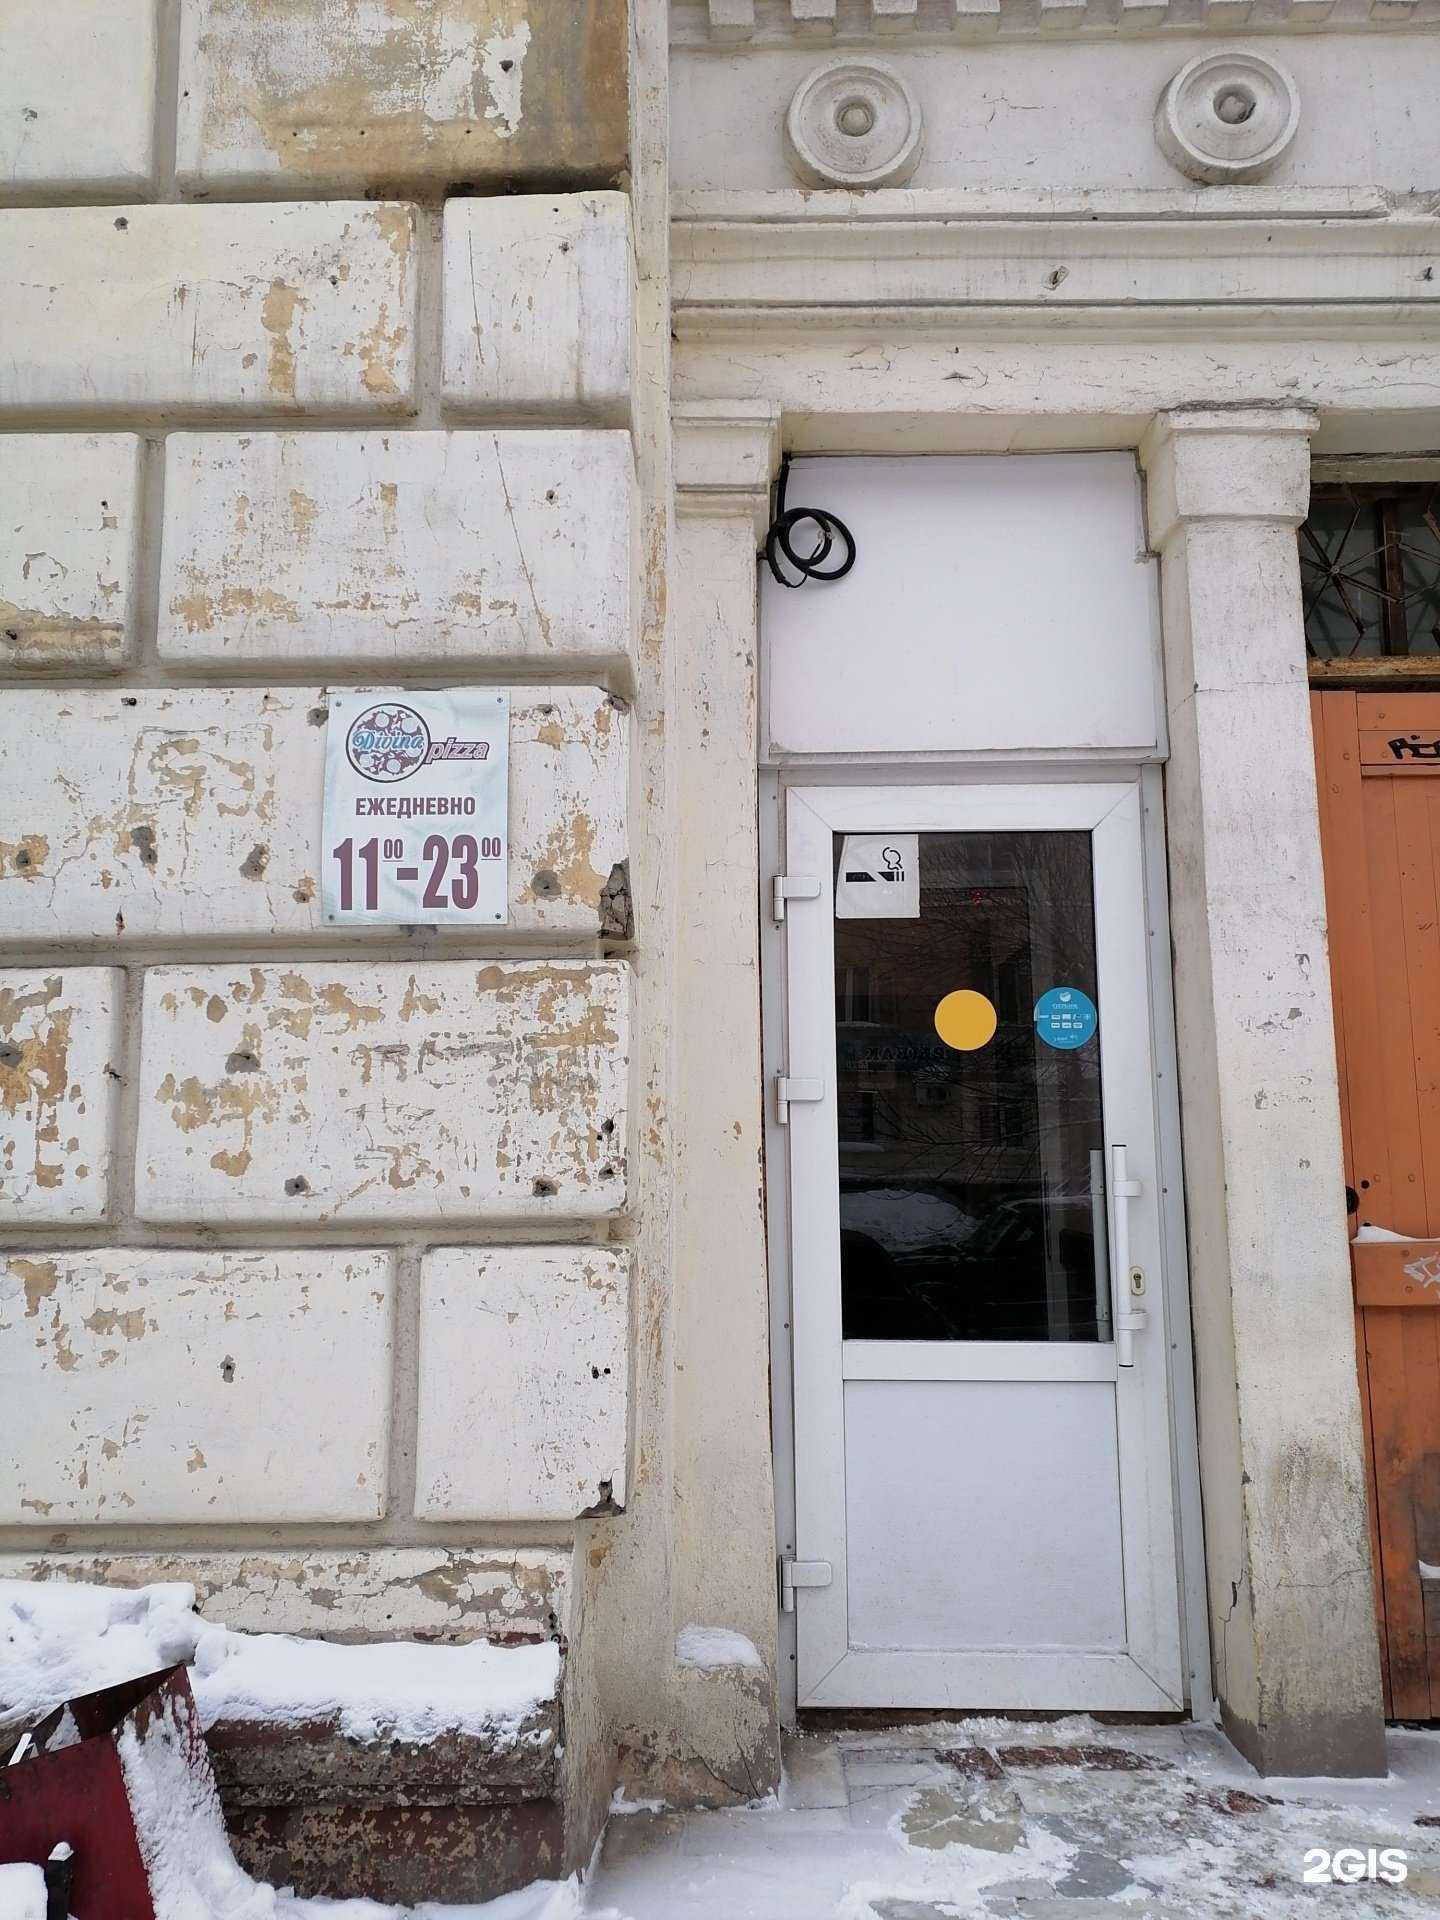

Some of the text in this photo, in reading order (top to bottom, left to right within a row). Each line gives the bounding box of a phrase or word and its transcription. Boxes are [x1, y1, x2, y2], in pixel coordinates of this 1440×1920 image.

[352, 730, 489, 764] Divina pizza
[355, 796, 476, 819] ЕЖЕДНЕВНО
